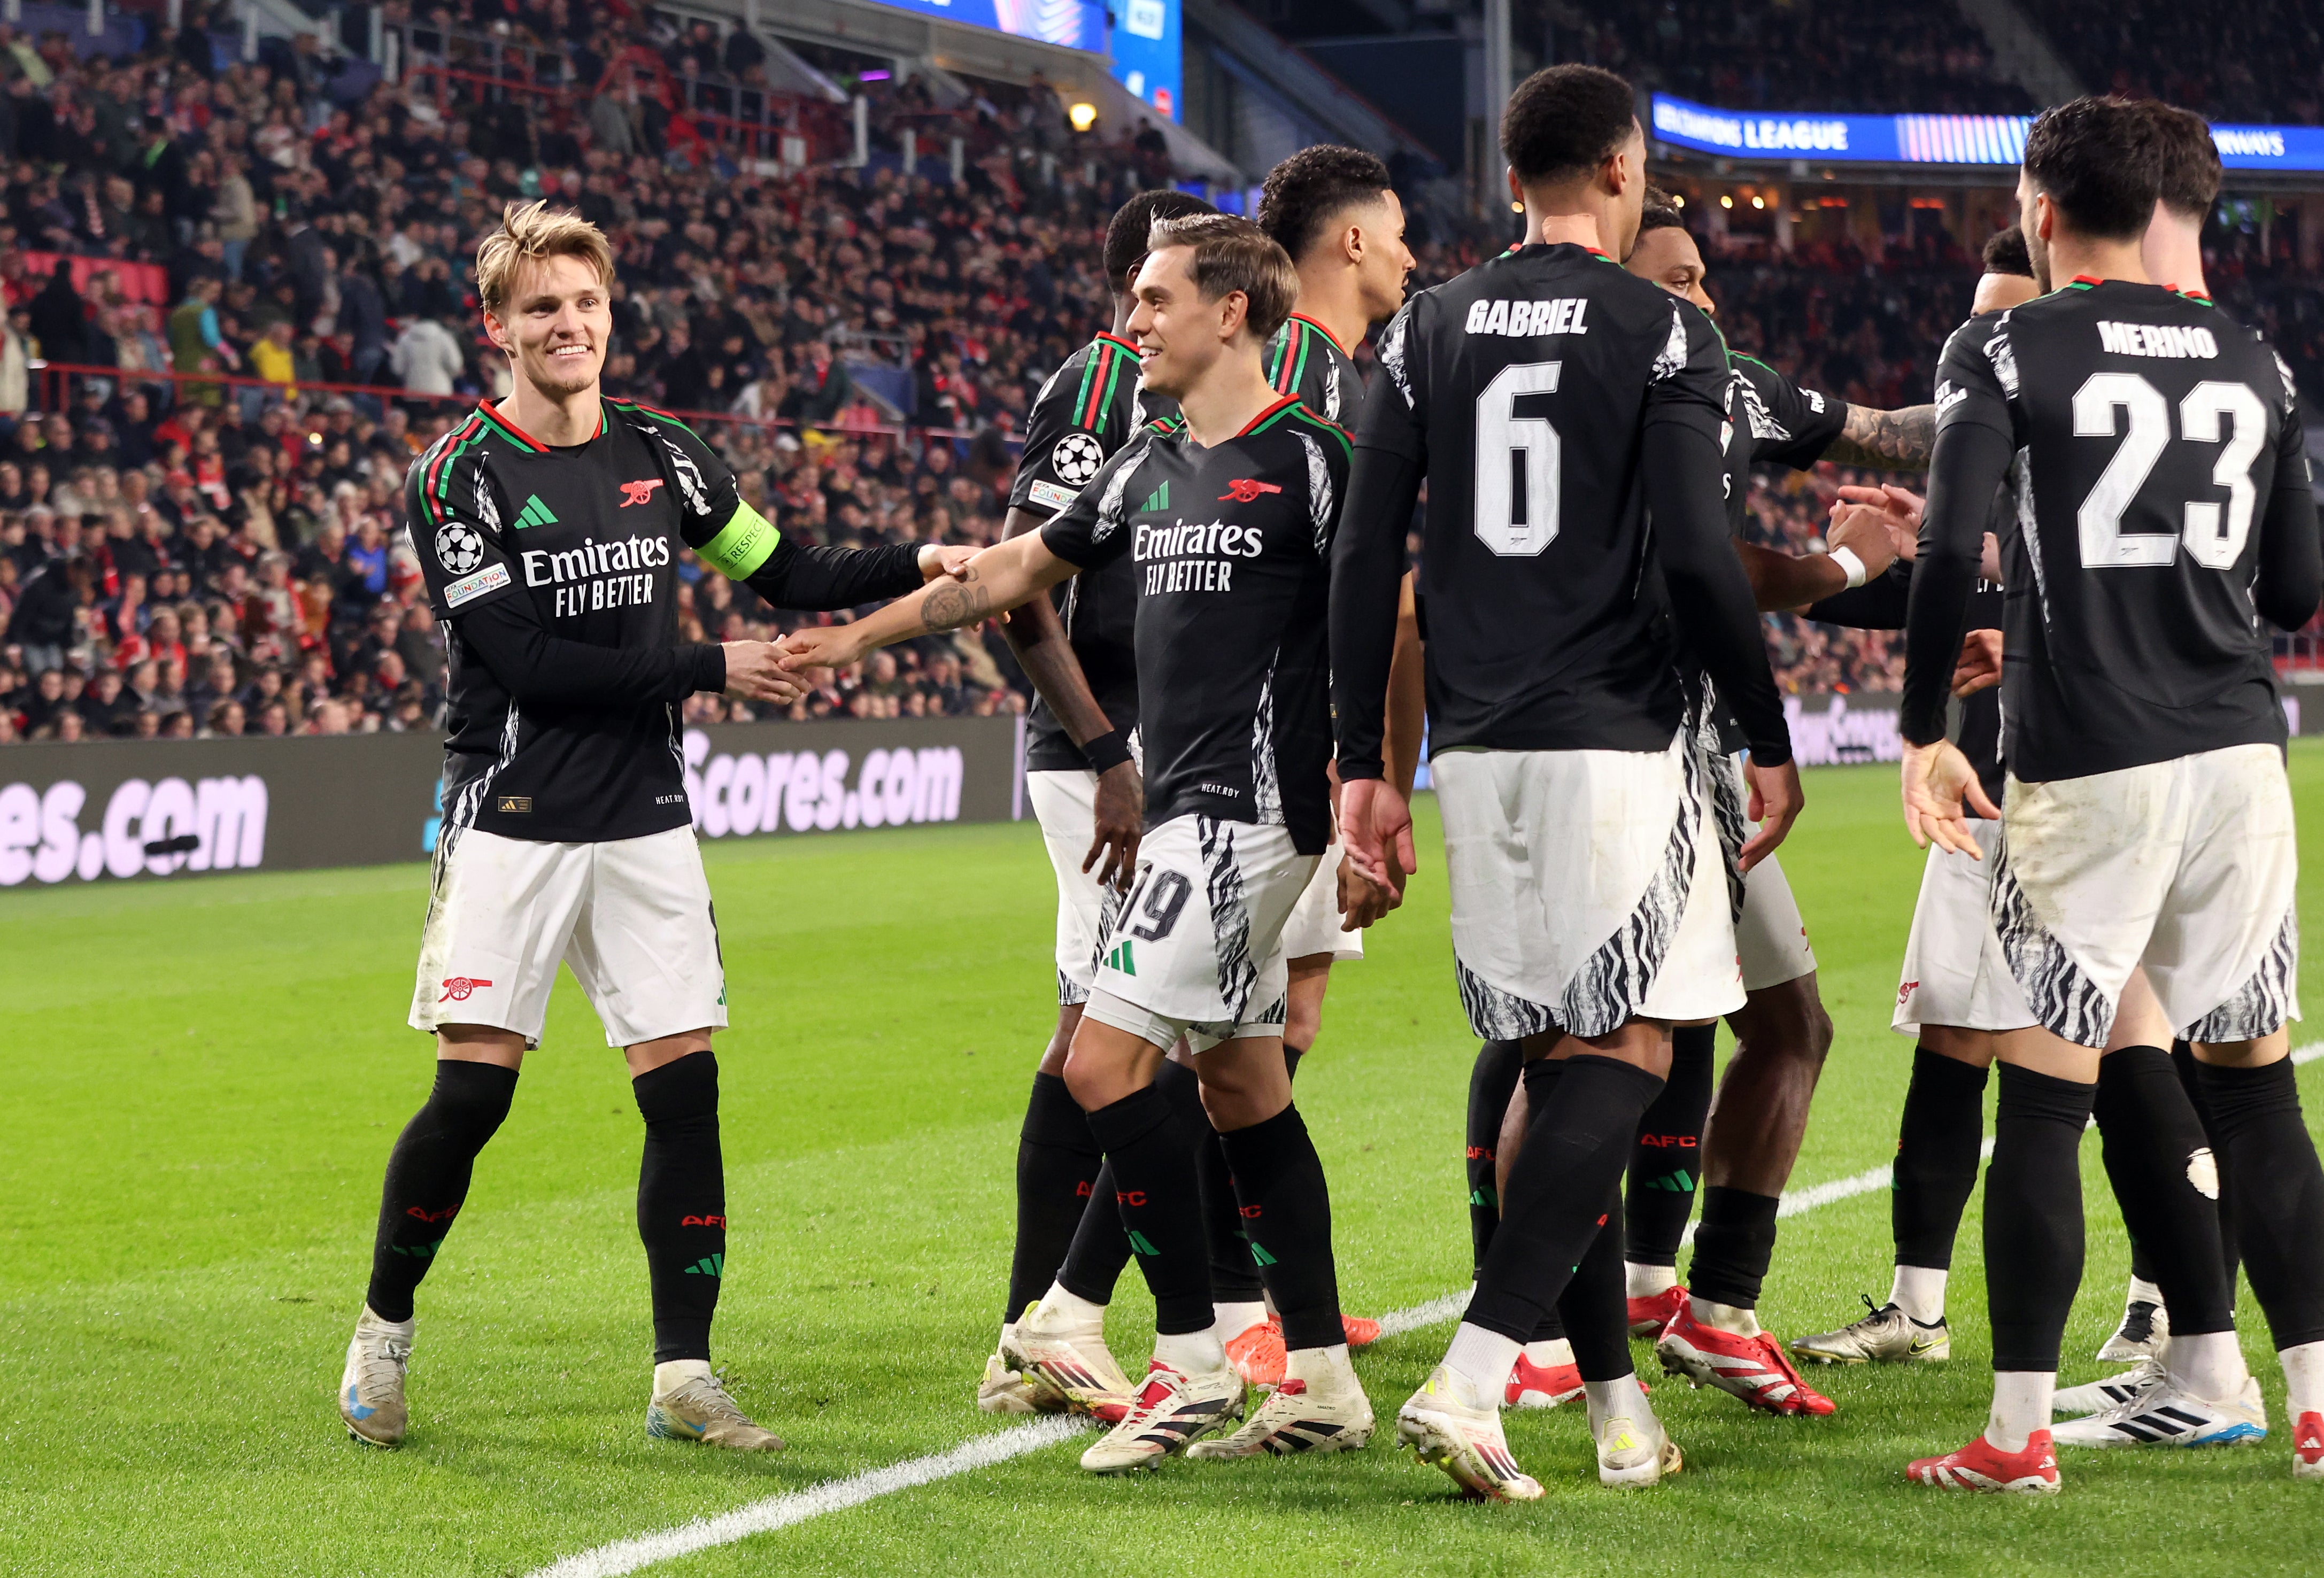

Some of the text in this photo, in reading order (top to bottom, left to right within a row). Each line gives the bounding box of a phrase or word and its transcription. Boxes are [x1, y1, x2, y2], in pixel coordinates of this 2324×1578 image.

[1744, 119, 1848, 150] LEAGUE
[1465, 298, 1589, 337] GABRIEL
[2096, 320, 2219, 359] MERINO
[1474, 360, 1563, 557] 6
[2072, 372, 2268, 571] 23
[1032, 486, 1074, 504] FOUNDA
[730, 519, 763, 560] RESPECT
[1133, 518, 1263, 562] Emirates
[520, 533, 669, 587] Emirates
[1145, 560, 1232, 597] FLY BETTER
[447, 569, 507, 601] FOUNDATION
[555, 573, 654, 618] FLY BETTER
[655, 794, 684, 805] HEAT.RDY
[1201, 783, 1240, 799] HEAT.RDY
[1115, 862, 1194, 944] 19
[1641, 1134, 1696, 1148] AFC
[1462, 1426, 1502, 1447] F50
